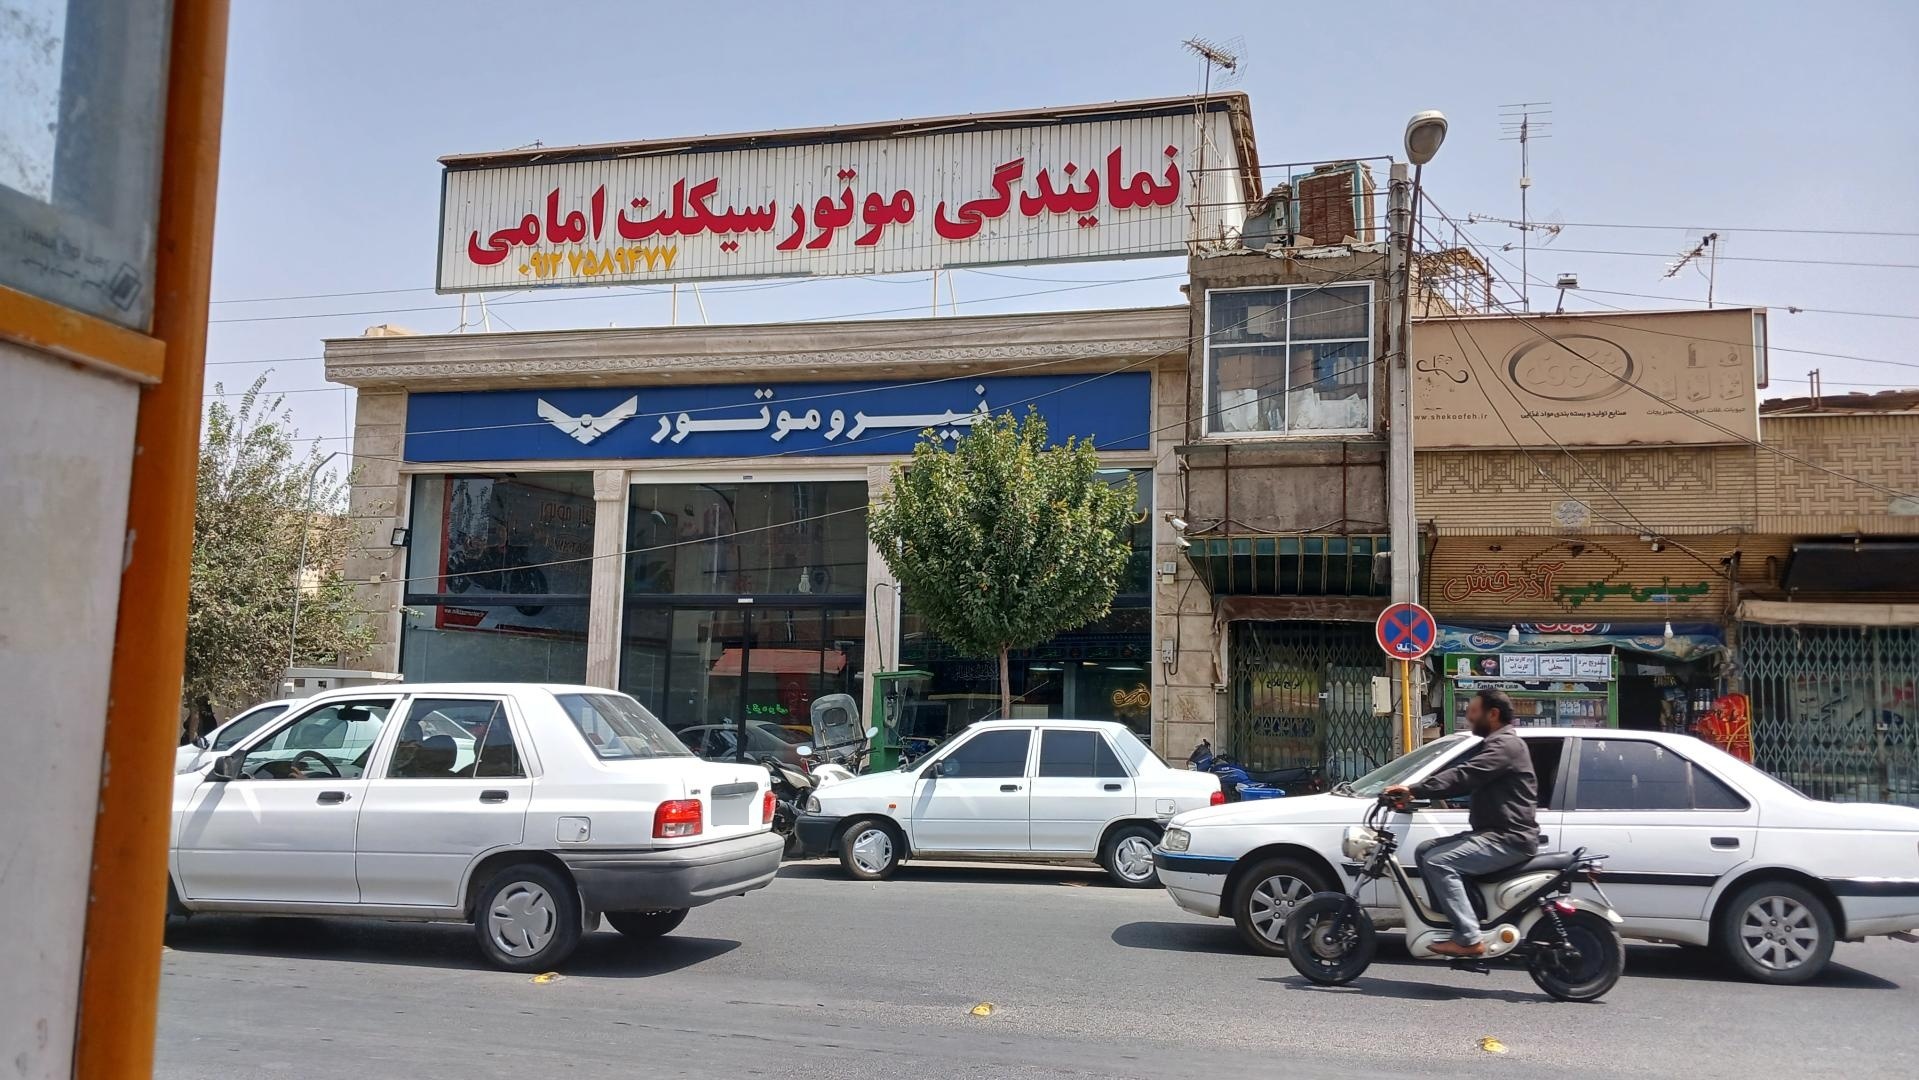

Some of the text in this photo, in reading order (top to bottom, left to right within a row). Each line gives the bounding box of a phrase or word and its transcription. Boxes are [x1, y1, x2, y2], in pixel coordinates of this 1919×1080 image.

[467, 184, 605, 266] امامی
[934, 144, 1181, 241] نمایندگی
[1444, 562, 1565, 603] آذرخش
